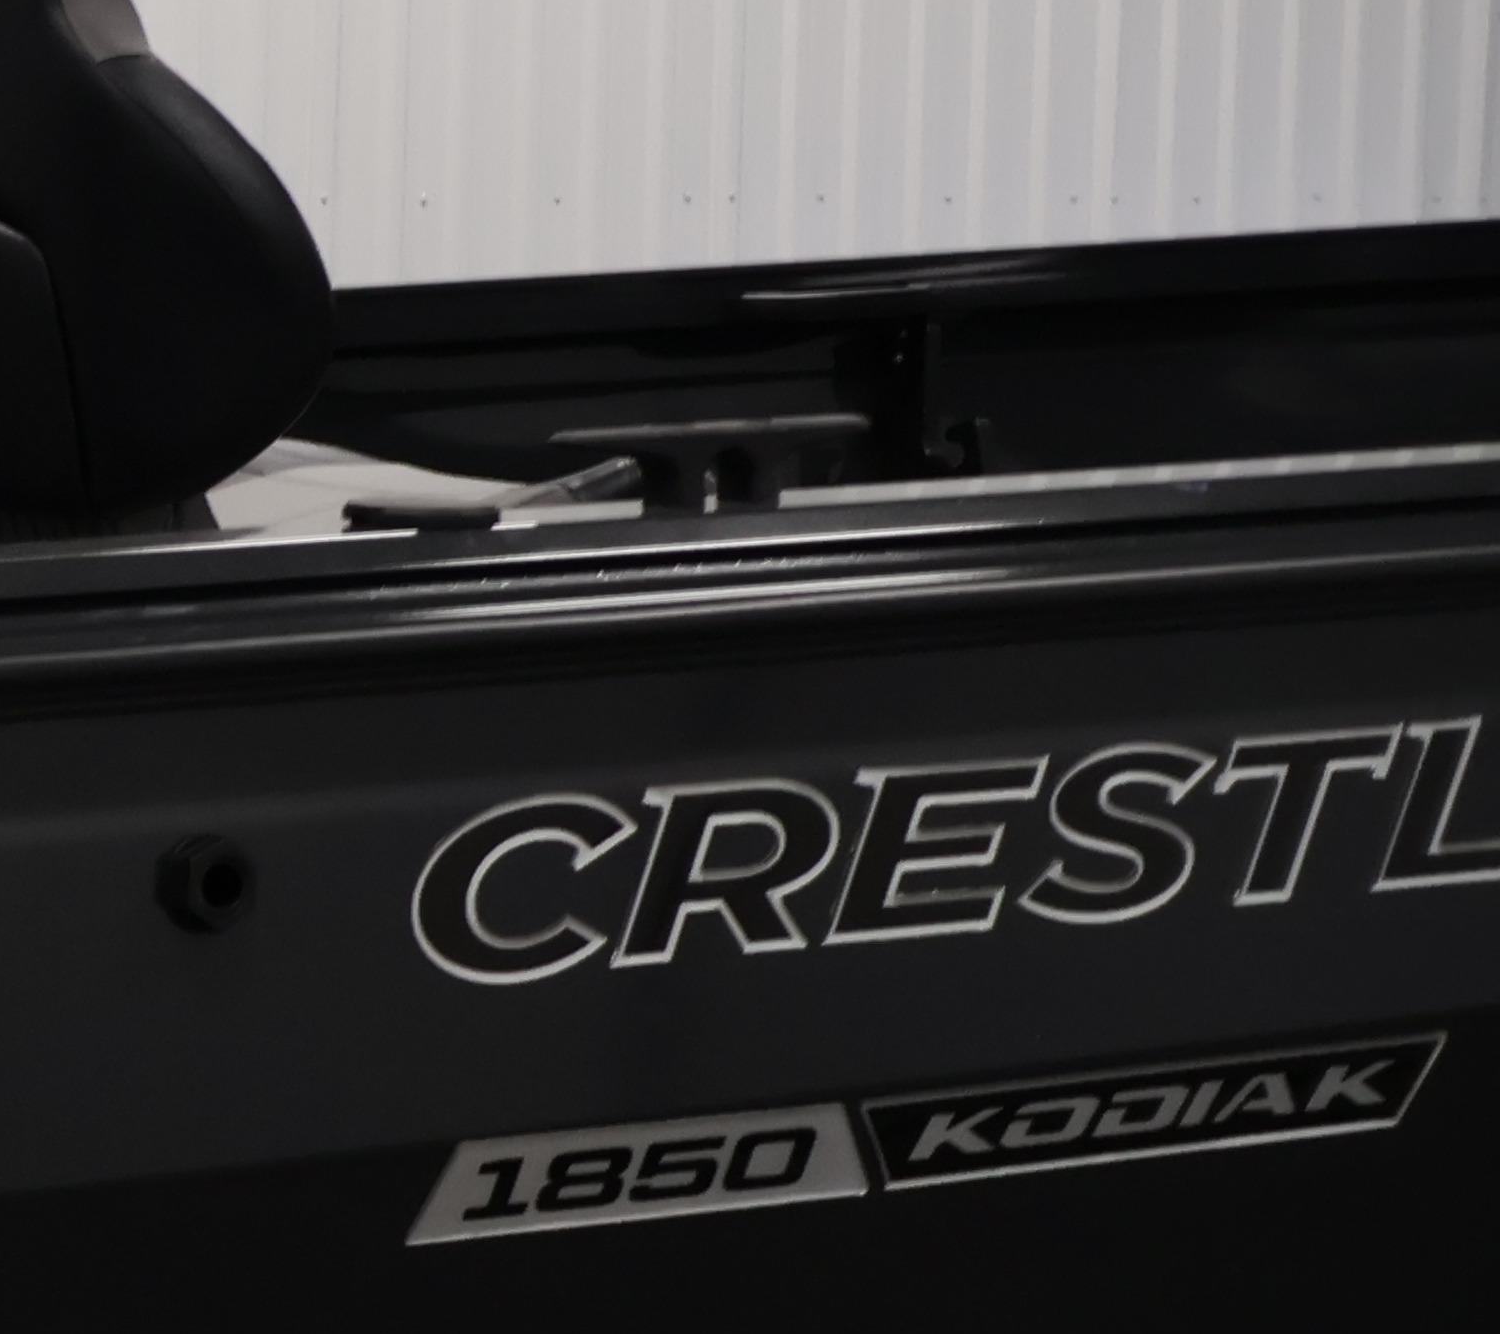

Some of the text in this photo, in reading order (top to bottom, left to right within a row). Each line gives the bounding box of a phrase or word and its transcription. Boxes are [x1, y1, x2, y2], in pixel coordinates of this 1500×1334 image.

[410, 713, 1500, 987] CRESTL
[461, 1055, 1396, 1221] 1850 KODIAK
